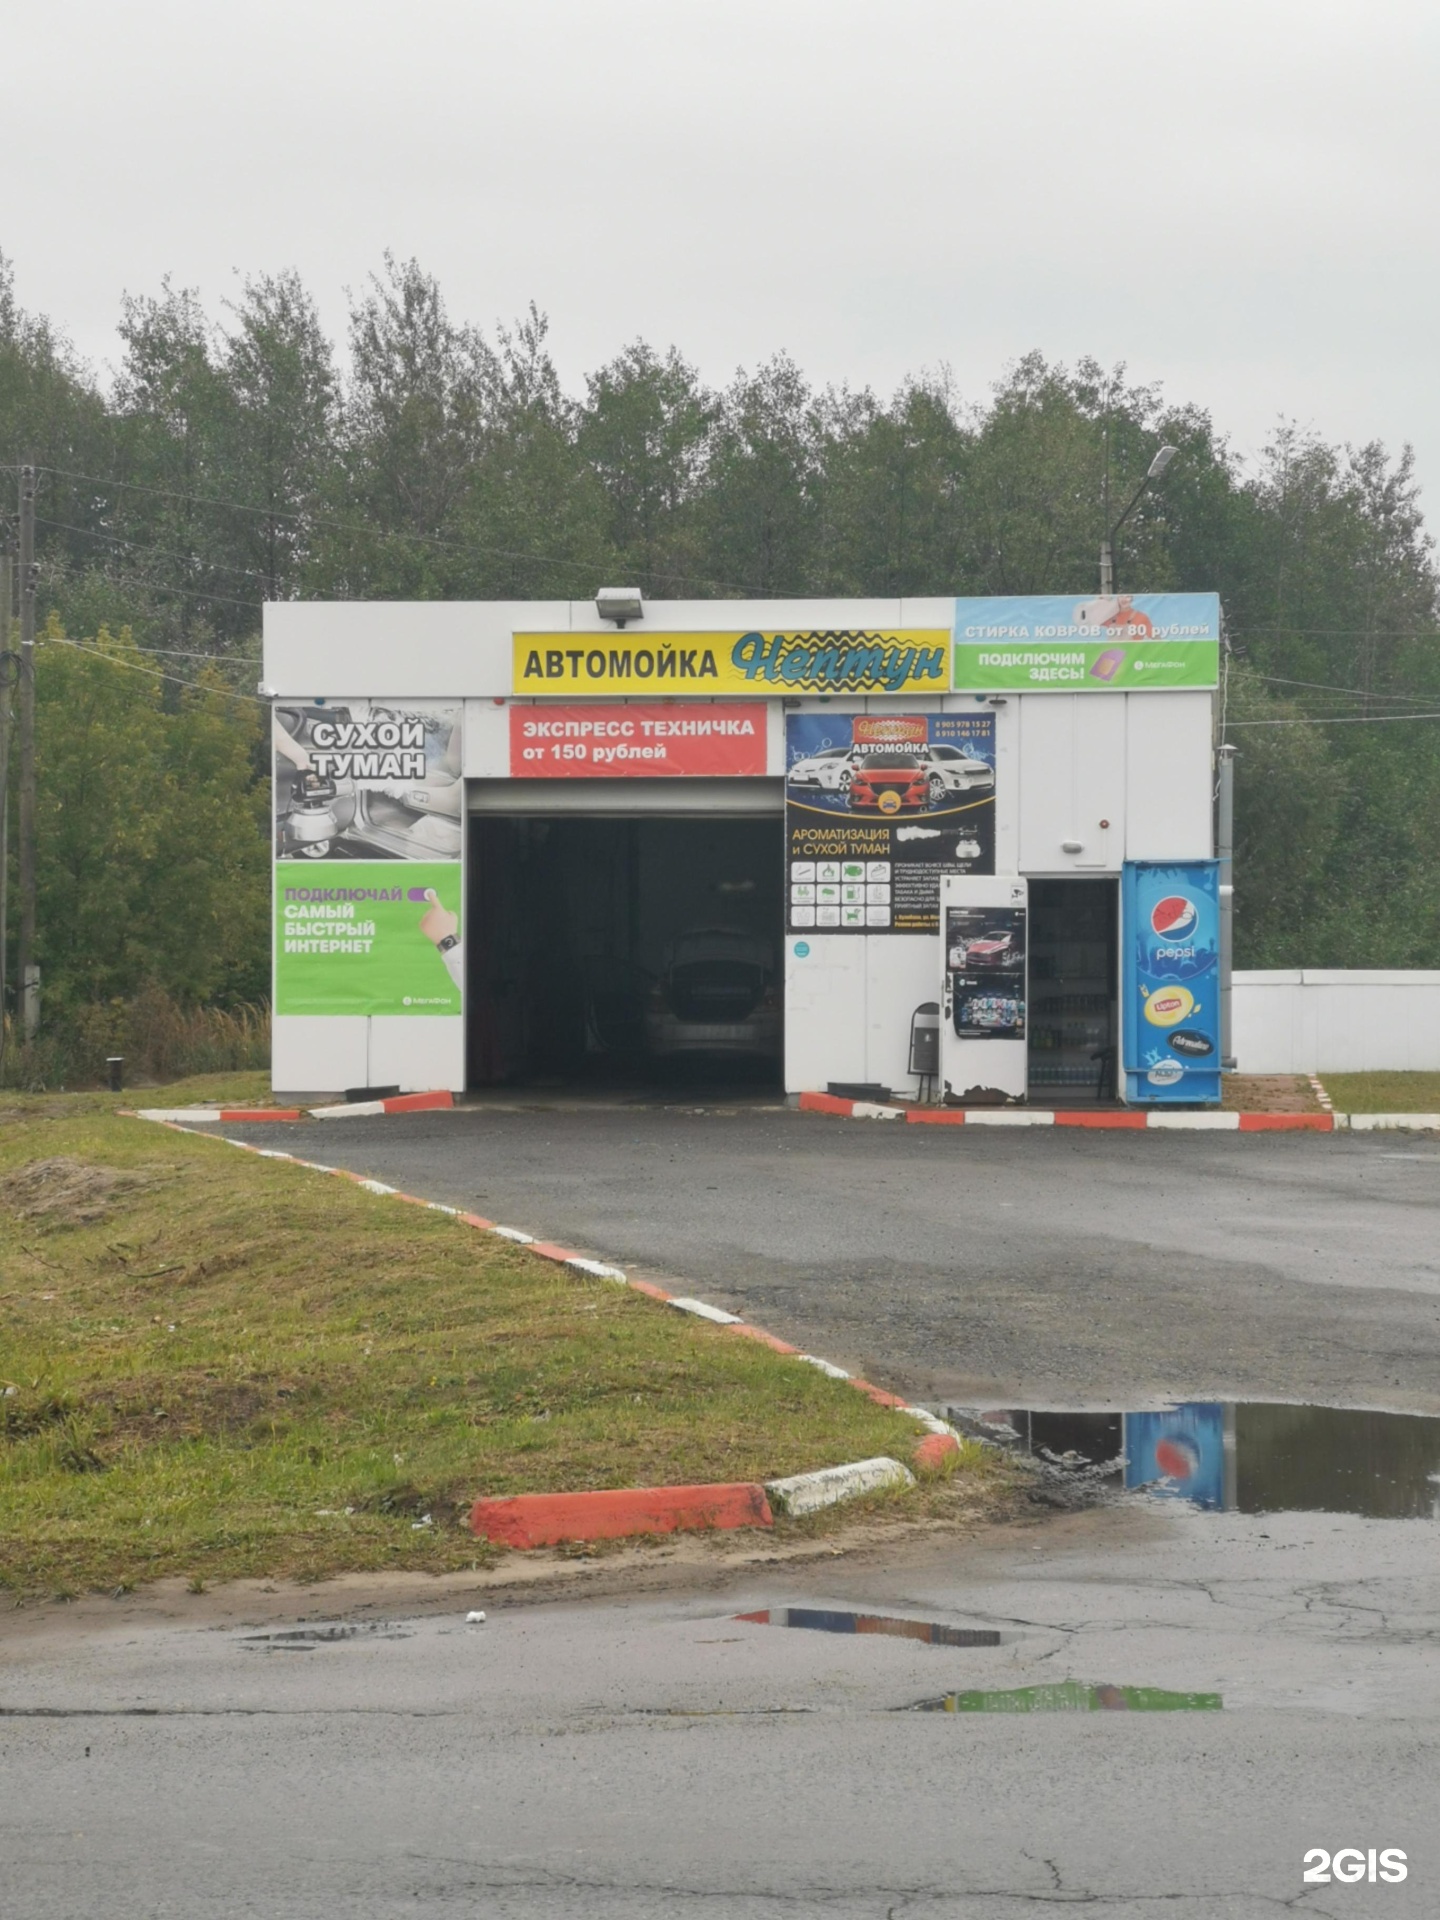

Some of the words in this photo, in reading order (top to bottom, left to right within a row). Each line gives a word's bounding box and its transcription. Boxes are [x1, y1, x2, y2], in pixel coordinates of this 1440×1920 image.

[965, 626, 1029, 638] СТИРКА
[1035, 625, 1101, 637] КОВРОВ
[1106, 627, 1122, 637] от
[1128, 625, 1146, 636] 80
[1152, 622, 1209, 638] рублей
[523, 643, 718, 678] АВТОМОЙКА
[731, 632, 944, 691] Нептун
[979, 653, 1085, 666] ПОДКЛЮЧИМ
[1029, 668, 1084, 680] ЗДЕСЬ!
[312, 718, 425, 748] СУХОЙ
[523, 721, 634, 737] ЭКСПРЕСС
[641, 720, 755, 736] ТЕХНИЧКА
[523, 748, 544, 759] от
[551, 744, 586, 759] 150
[593, 743, 667, 762] рублей
[853, 742, 929, 753] АВТОМОЙКА
[312, 754, 425, 777] ТУМАН
[792, 829, 890, 841] АРОМАТИЗАЦИЯ
[803, 842, 847, 855] СУХОЙ
[851, 844, 890, 854] ТУМАН
[285, 886, 402, 903] ПОДКЛЮЧАЙ
[284, 903, 354, 918] САМЫЙ
[285, 920, 375, 936] БЫСТРЫЙ
[285, 939, 372, 953] ИНТЕРНЕТ
[1156, 946, 1195, 960] pepsi
[1156, 1001, 1180, 1010] Lipton
